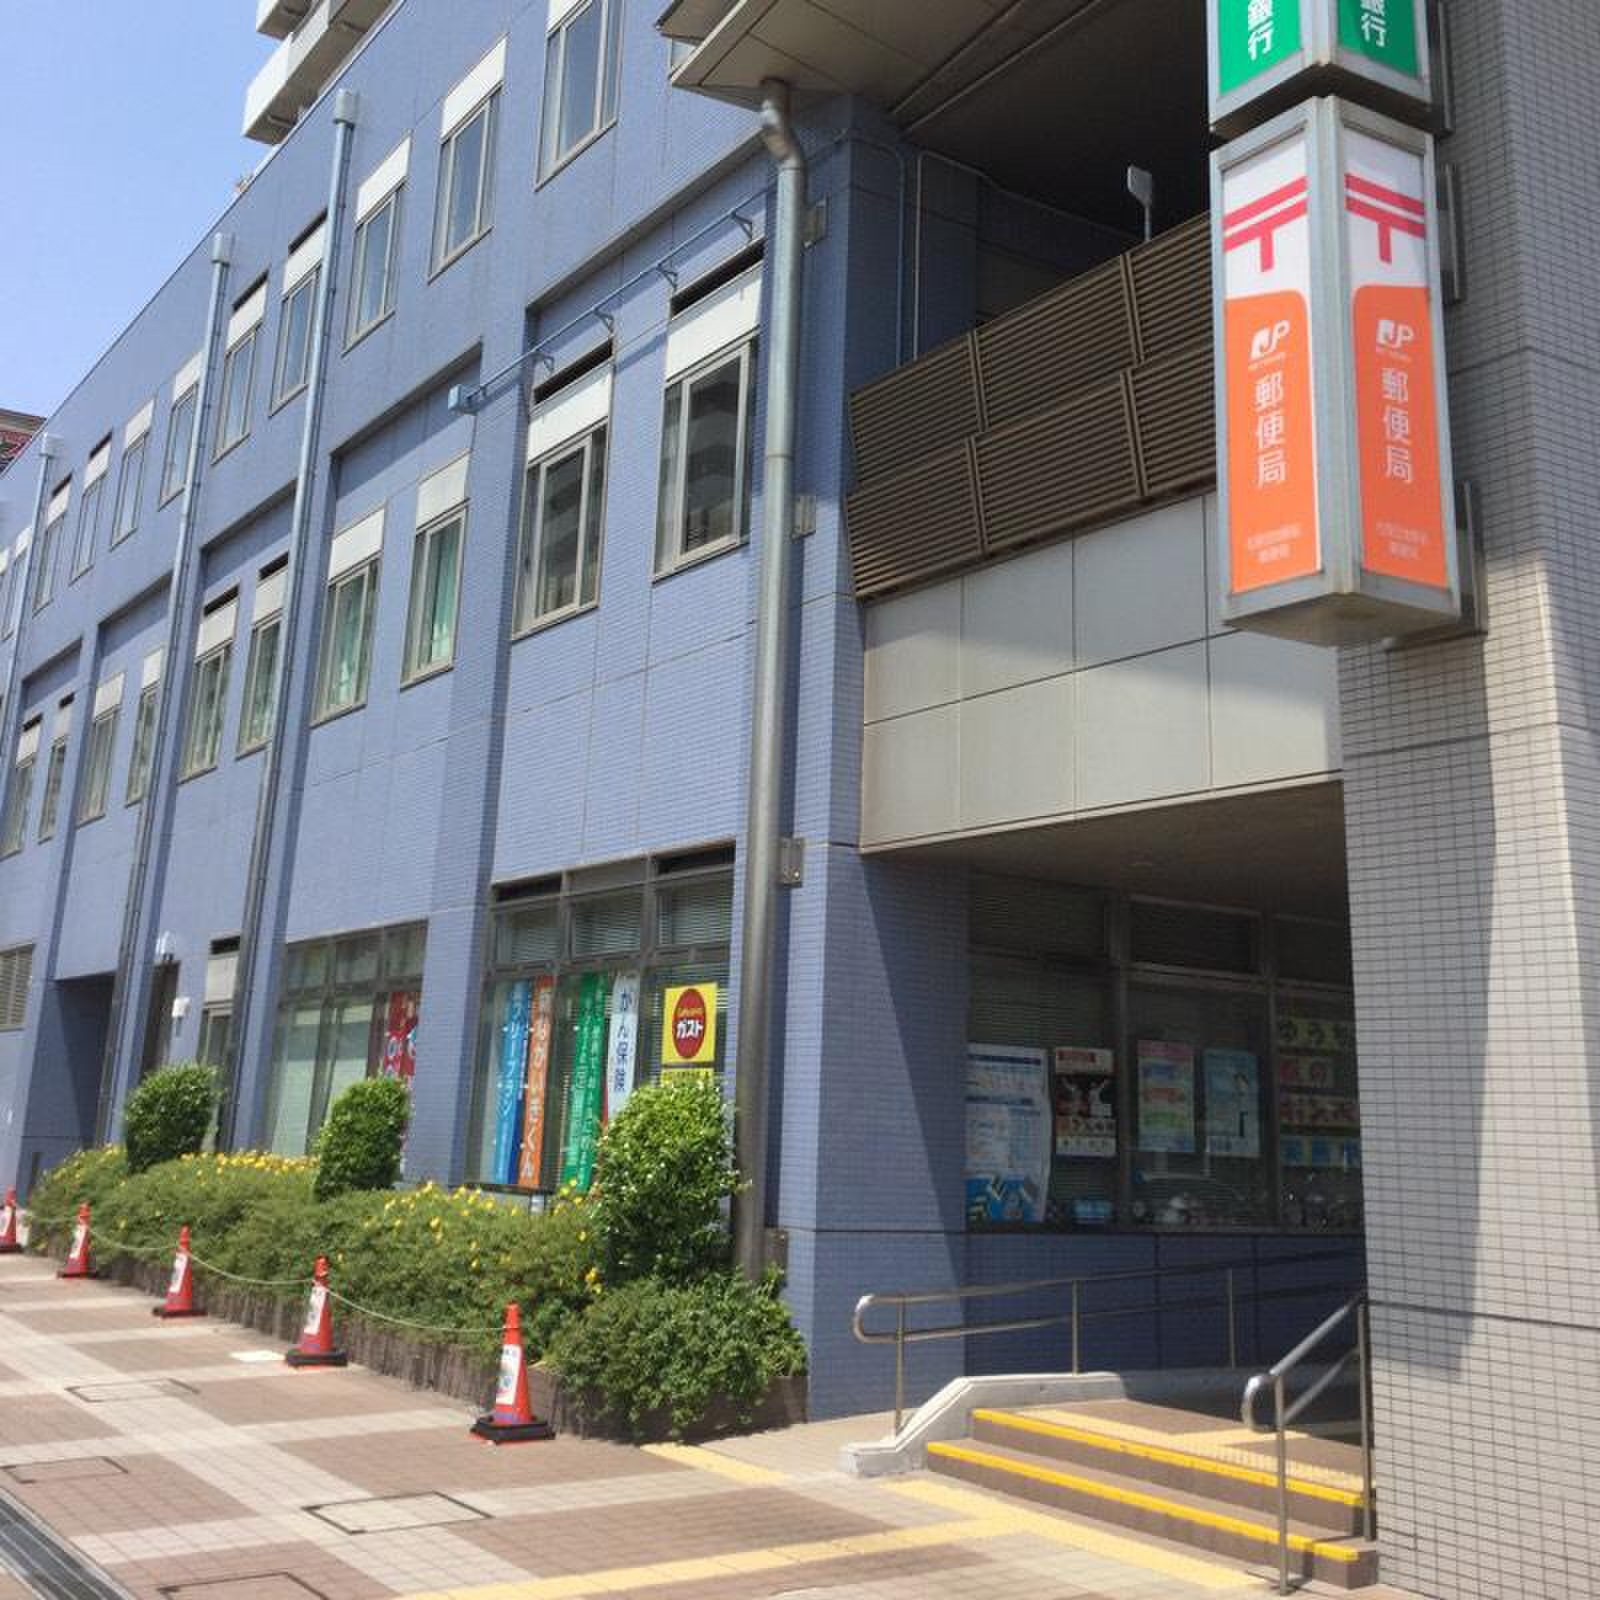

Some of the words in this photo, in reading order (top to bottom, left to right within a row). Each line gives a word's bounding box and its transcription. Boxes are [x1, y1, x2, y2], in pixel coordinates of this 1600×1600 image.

[1254, 370, 1287, 490] 郵便局
[1382, 367, 1413, 484] 郵便局
[676, 1017, 704, 1039] ガスト
